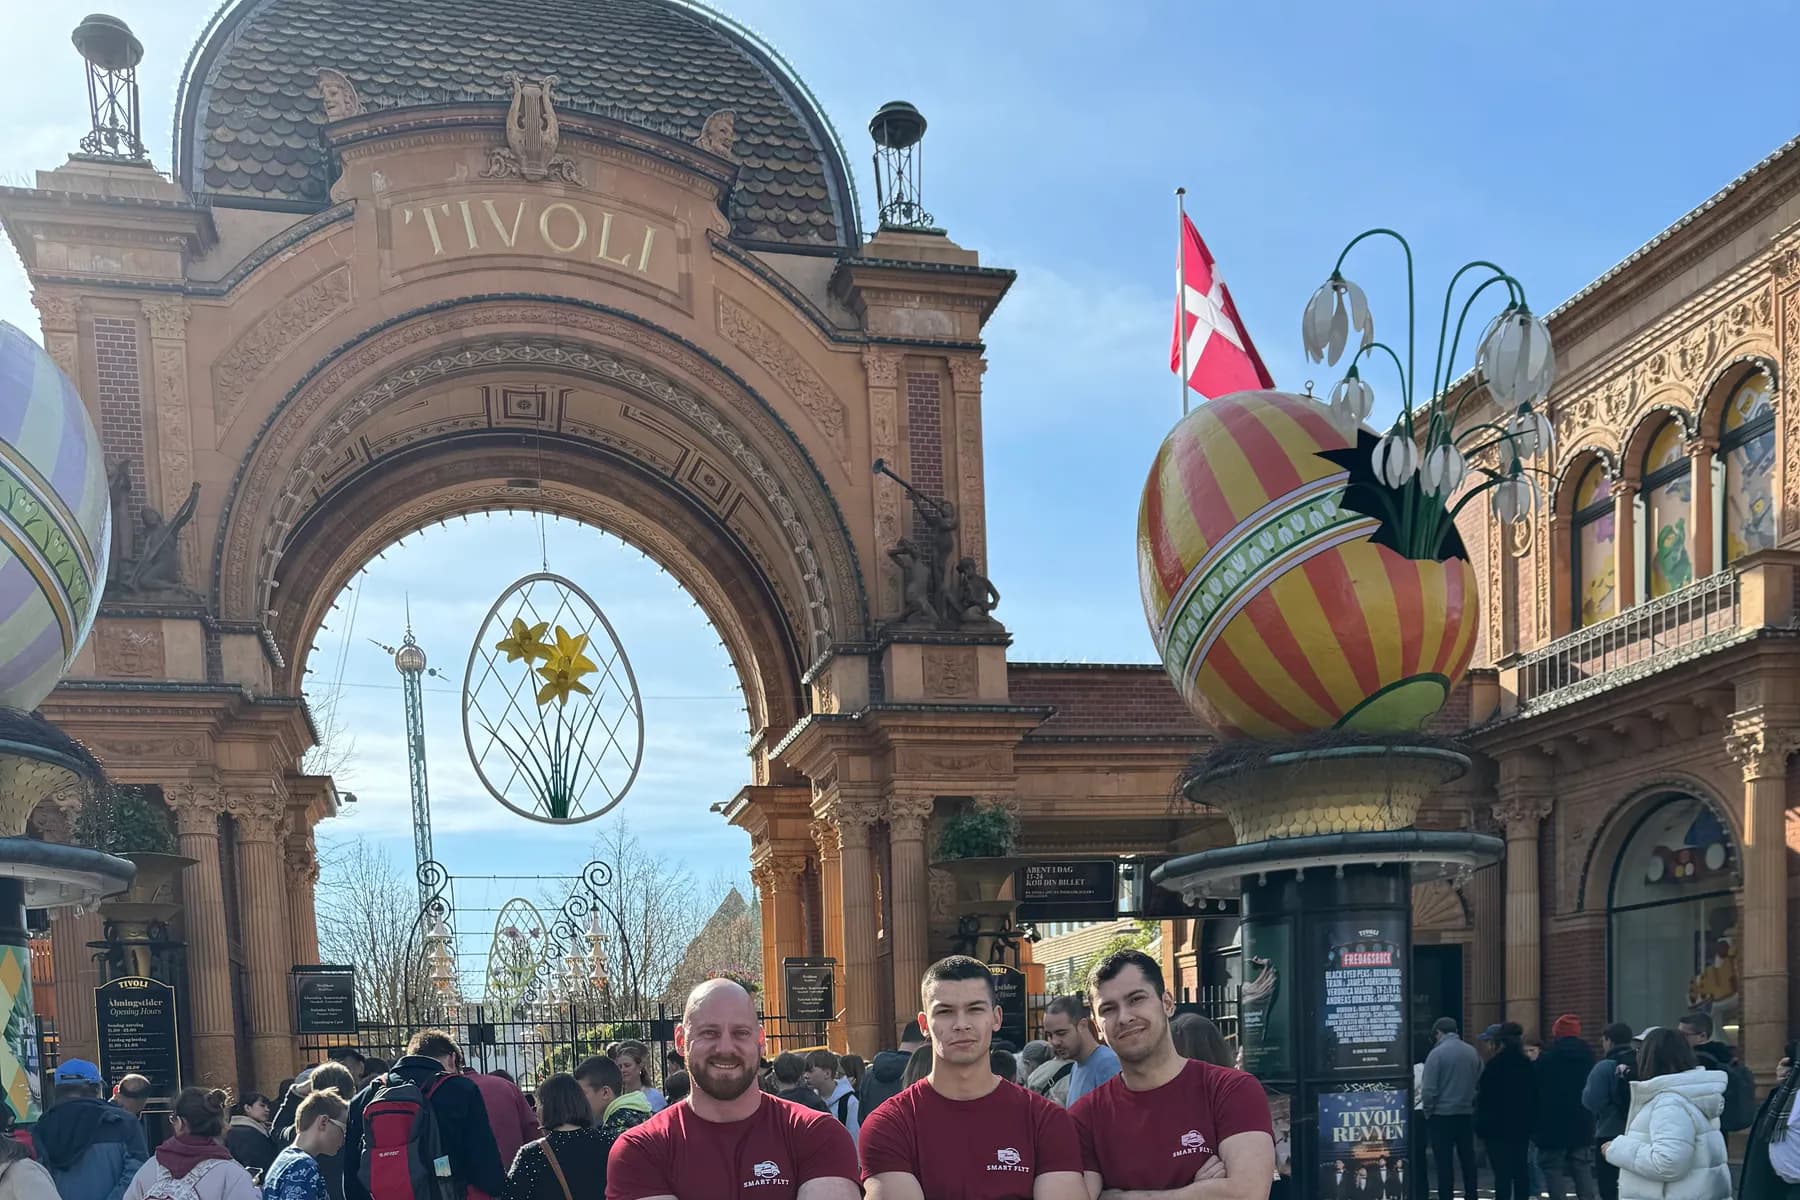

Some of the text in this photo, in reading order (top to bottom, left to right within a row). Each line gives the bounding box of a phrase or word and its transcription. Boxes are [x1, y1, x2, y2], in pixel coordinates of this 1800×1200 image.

[403, 199, 657, 273] TIVOLI
[1344, 952, 1391, 965] FREDAGSROCK
[118, 980, 149, 988] TIVOLI
[110, 1007, 162, 1017] Opening Hours
[1339, 1109, 1401, 1127] TIVOLI
[1333, 1124, 1403, 1142] REVYEN
[1173, 1148, 1198, 1158] SMART
[743, 1179, 771, 1188] SMART
